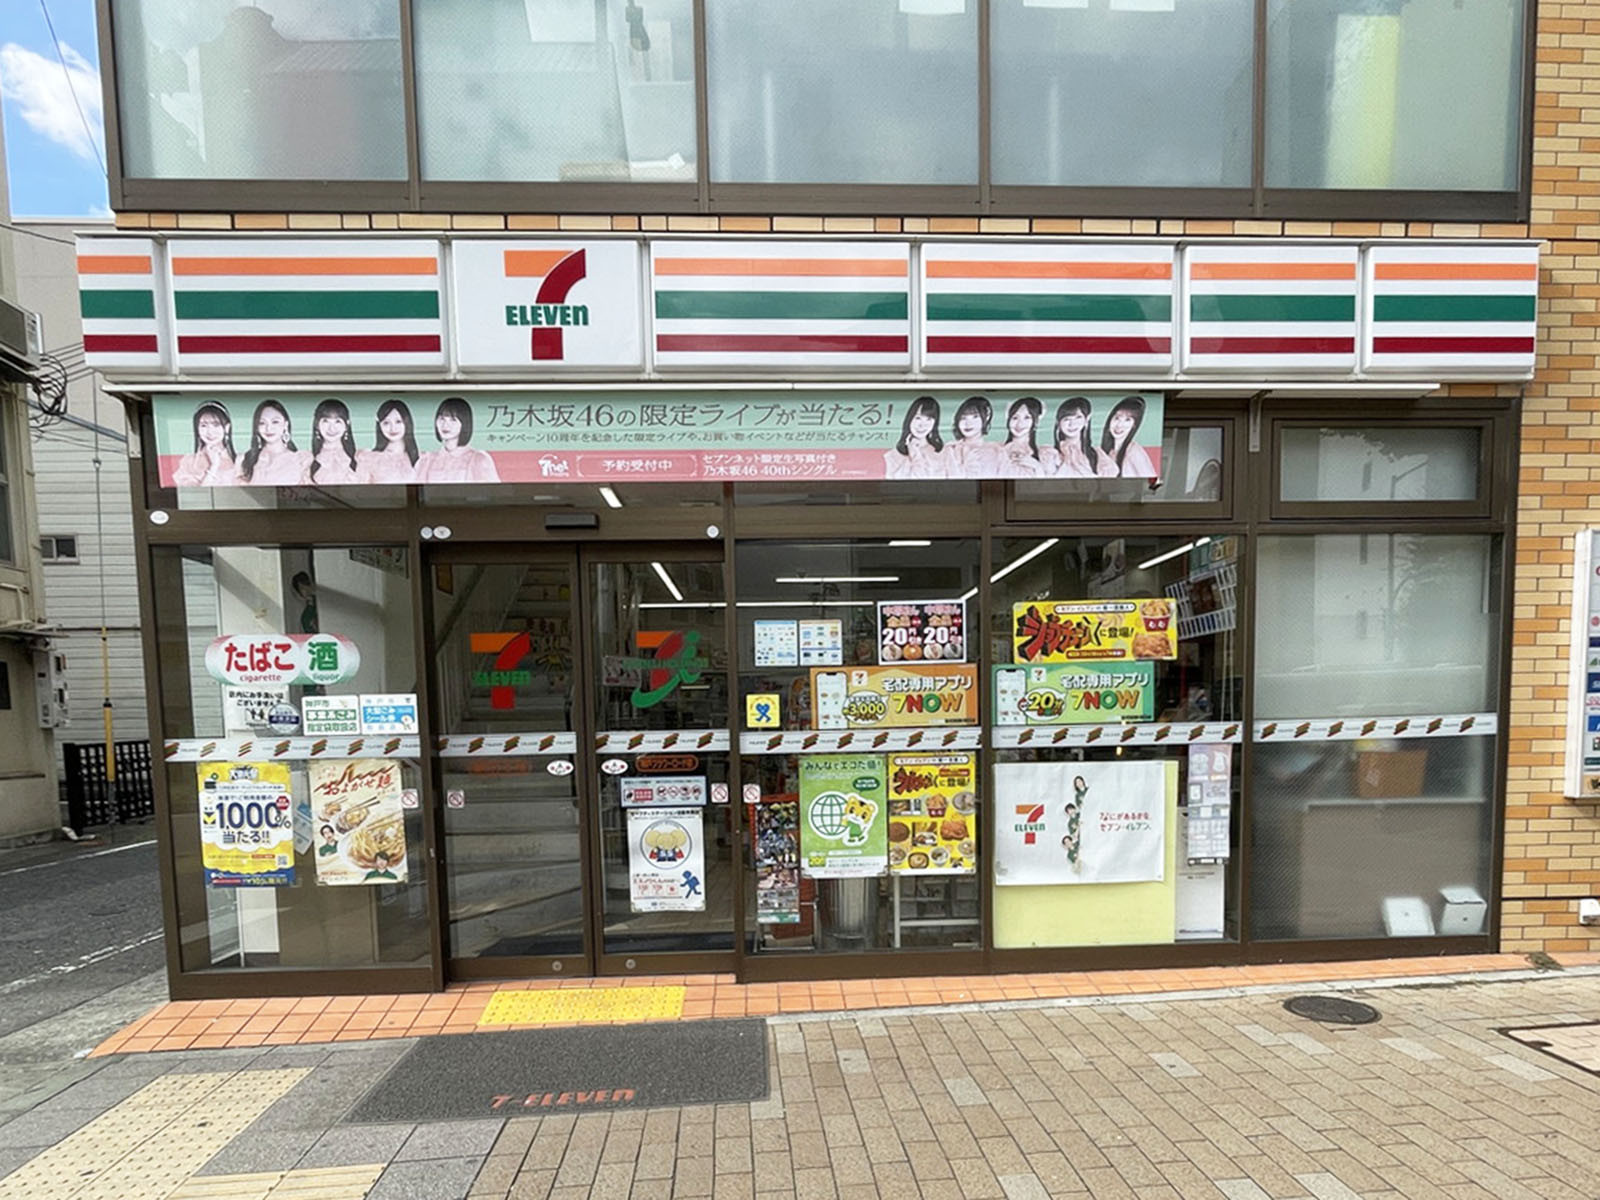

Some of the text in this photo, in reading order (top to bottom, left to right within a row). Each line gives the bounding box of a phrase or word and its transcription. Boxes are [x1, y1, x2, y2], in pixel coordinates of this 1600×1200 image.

[602, 460, 673, 473] 予約受付中
[224, 641, 295, 672] たばこ
[308, 641, 339, 671] 酒
[239, 673, 282, 682] cigarette
[312, 673, 340, 682] liquor
[892, 693, 964, 713] 7NOW
[1071, 690, 1140, 709] 7NOW
